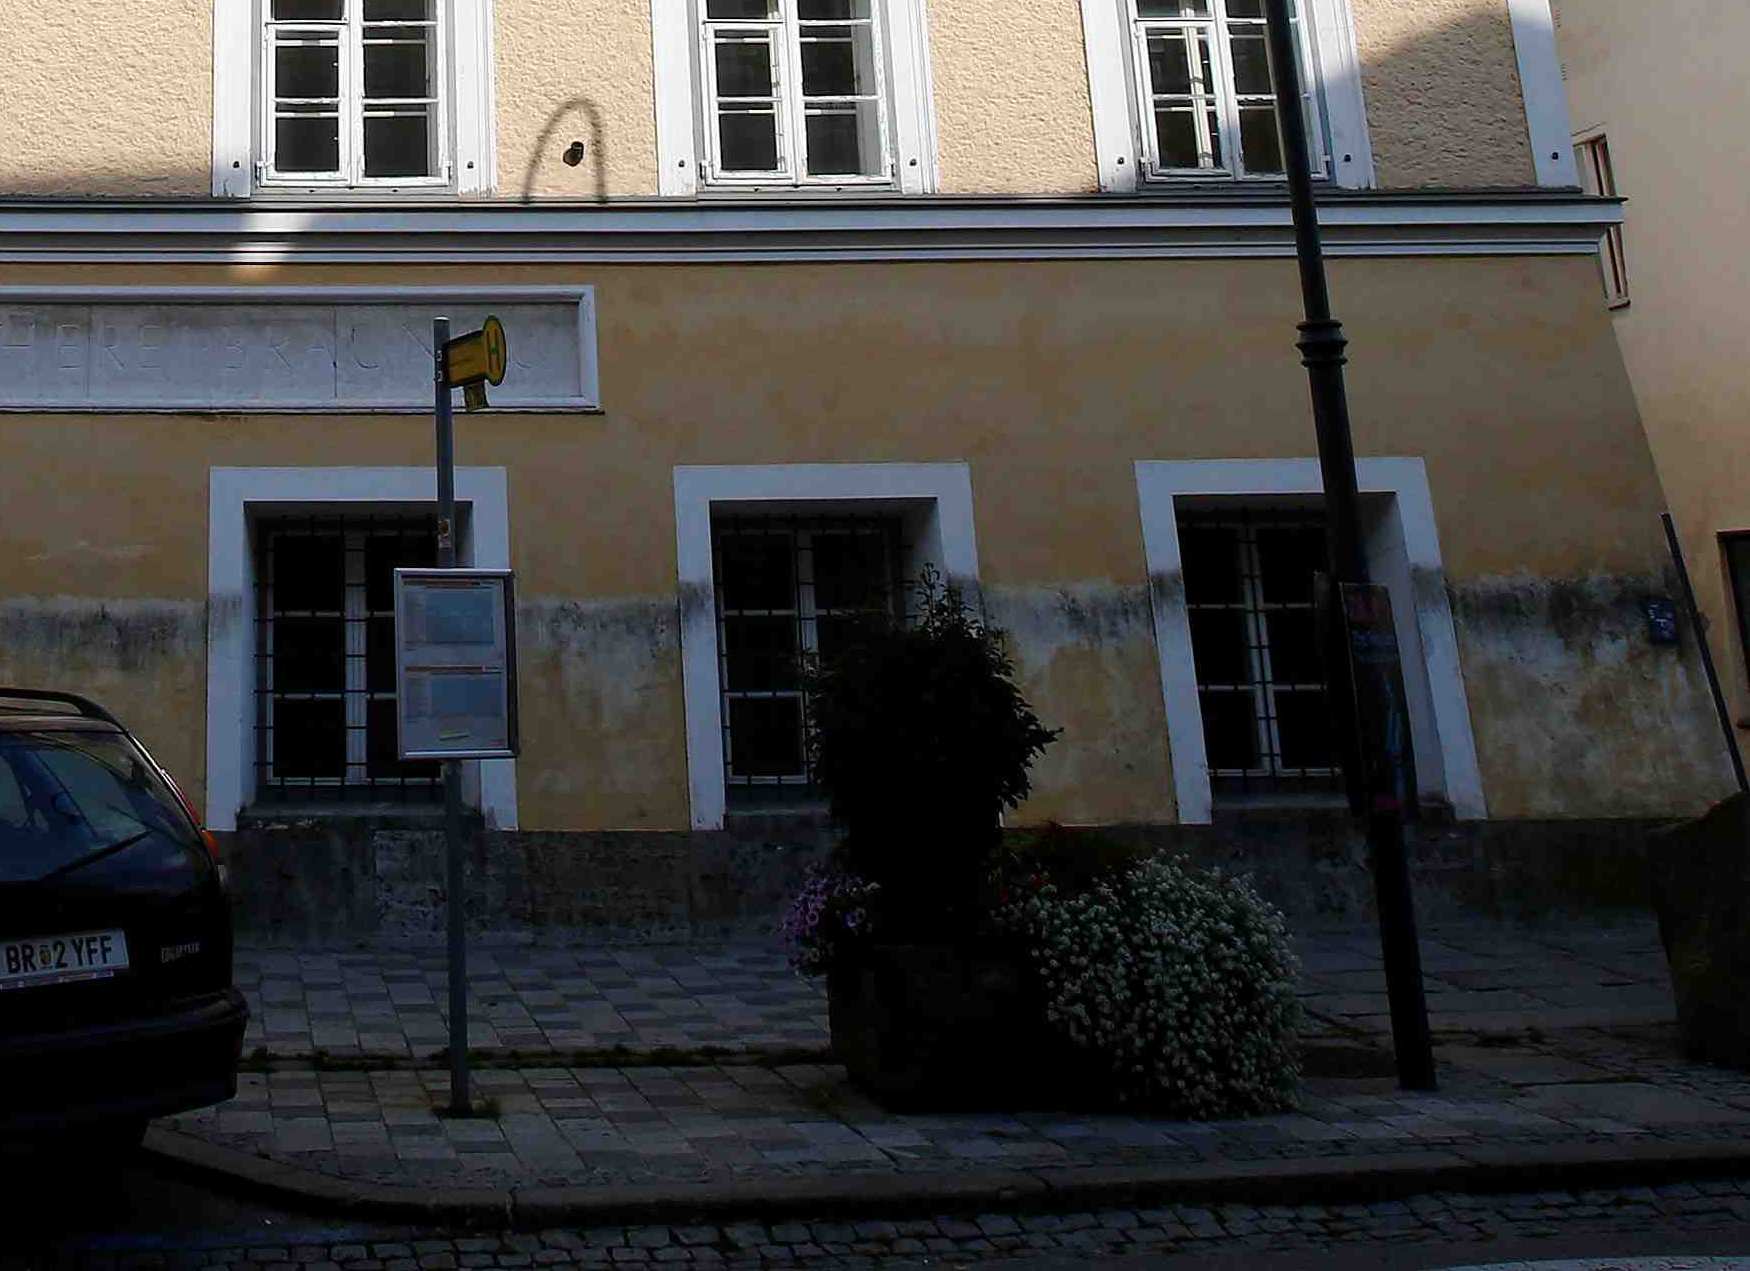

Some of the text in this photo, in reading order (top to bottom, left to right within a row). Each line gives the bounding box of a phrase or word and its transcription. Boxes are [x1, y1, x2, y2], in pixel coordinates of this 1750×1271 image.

[5, 935, 113, 975] BR 2 YFF
